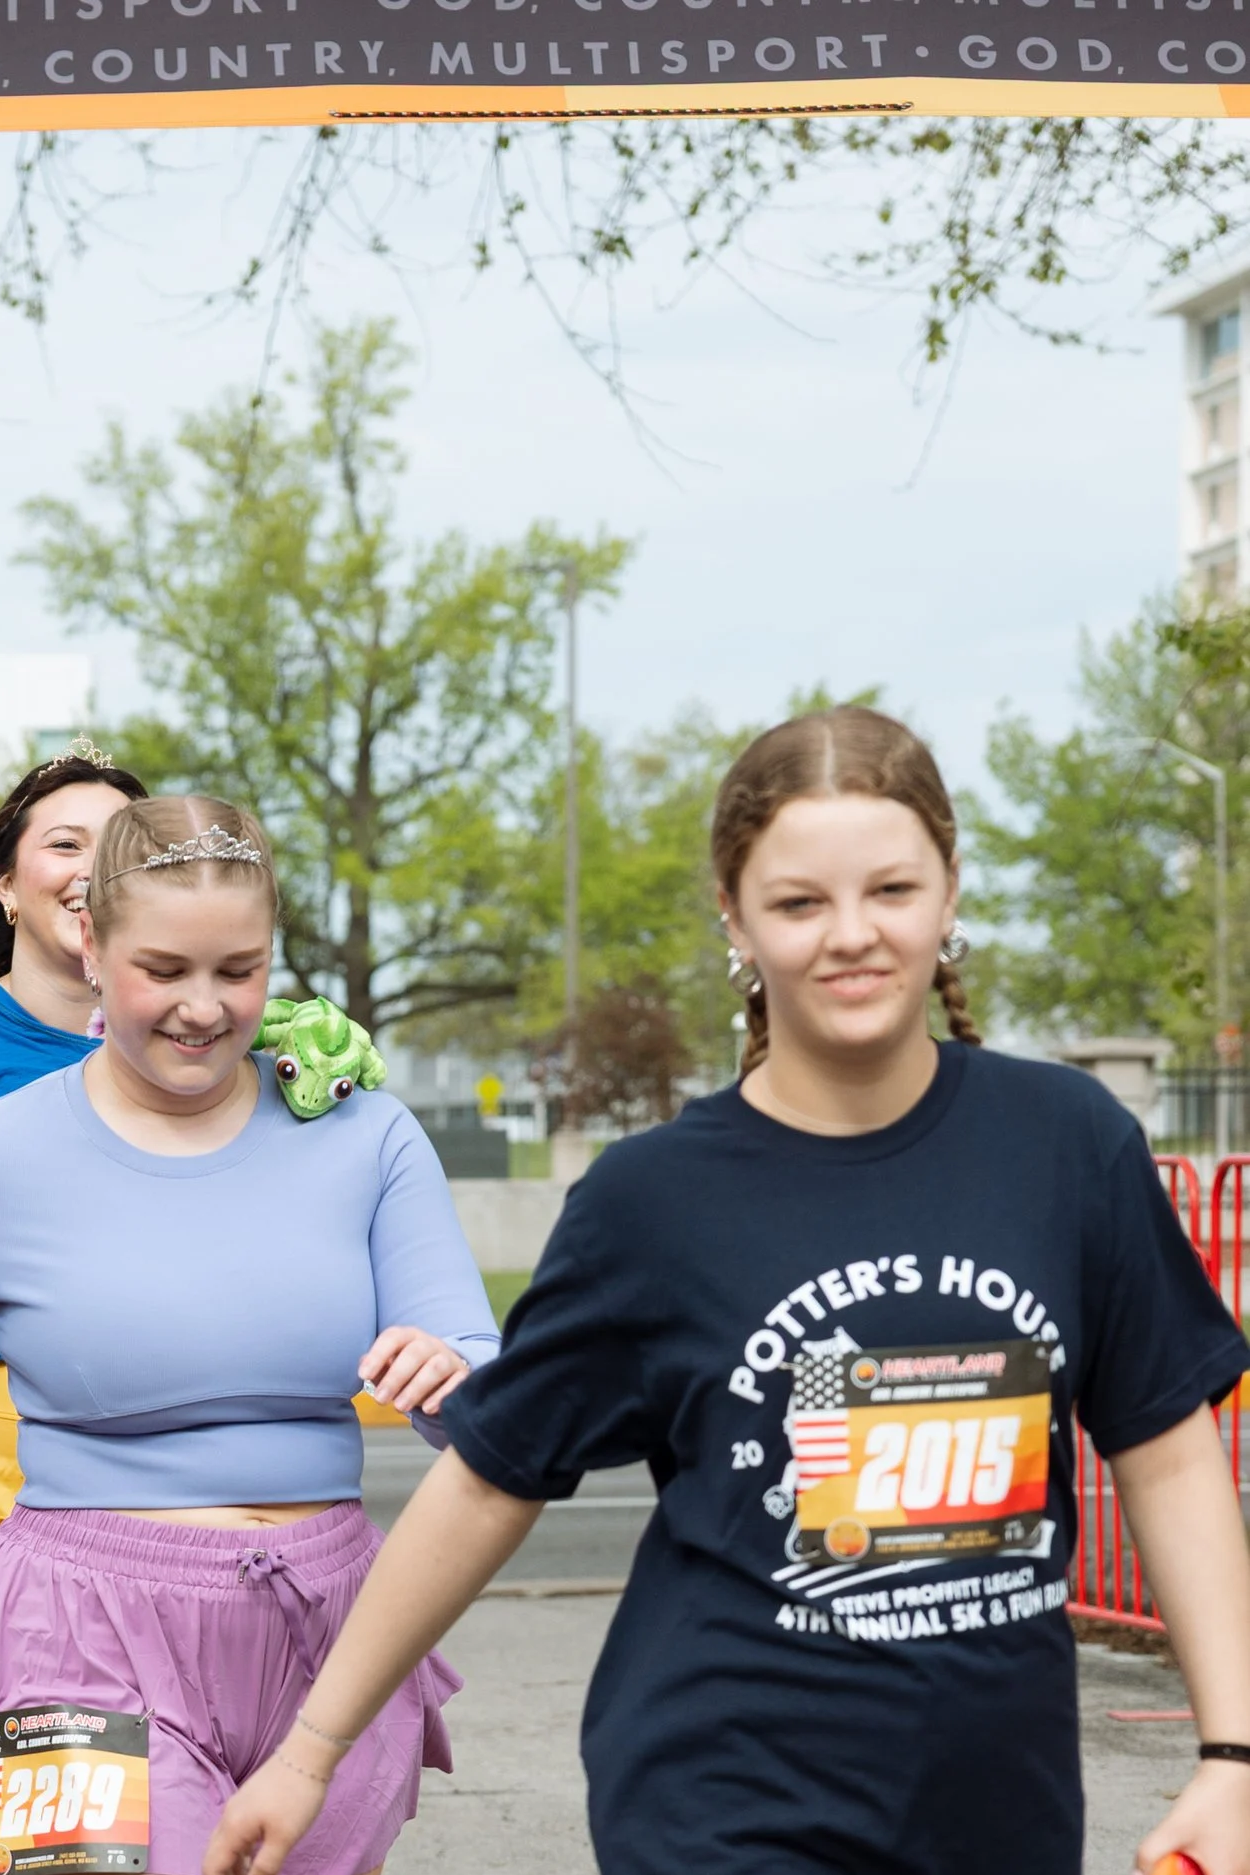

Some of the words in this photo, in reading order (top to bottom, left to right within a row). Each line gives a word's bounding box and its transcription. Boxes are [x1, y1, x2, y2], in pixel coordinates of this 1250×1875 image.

[44, 40, 395, 84] COUNTRY,
[429, 33, 888, 76] MULTISPORT
[957, 34, 1125, 75] GOD,
[1157, 39, 1247, 75] CO
[728, 1253, 923, 1405] POTTER'S
[730, 1439, 765, 1470] 20
[854, 1415, 1022, 1513] 2015
[775, 1603, 830, 1634] 4TH
[951, 1600, 987, 1633] 5K
[989, 1597, 1009, 1626] &
[831, 1590, 891, 1616] STEVE
[21, 1711, 107, 1732] HEARTLAND
